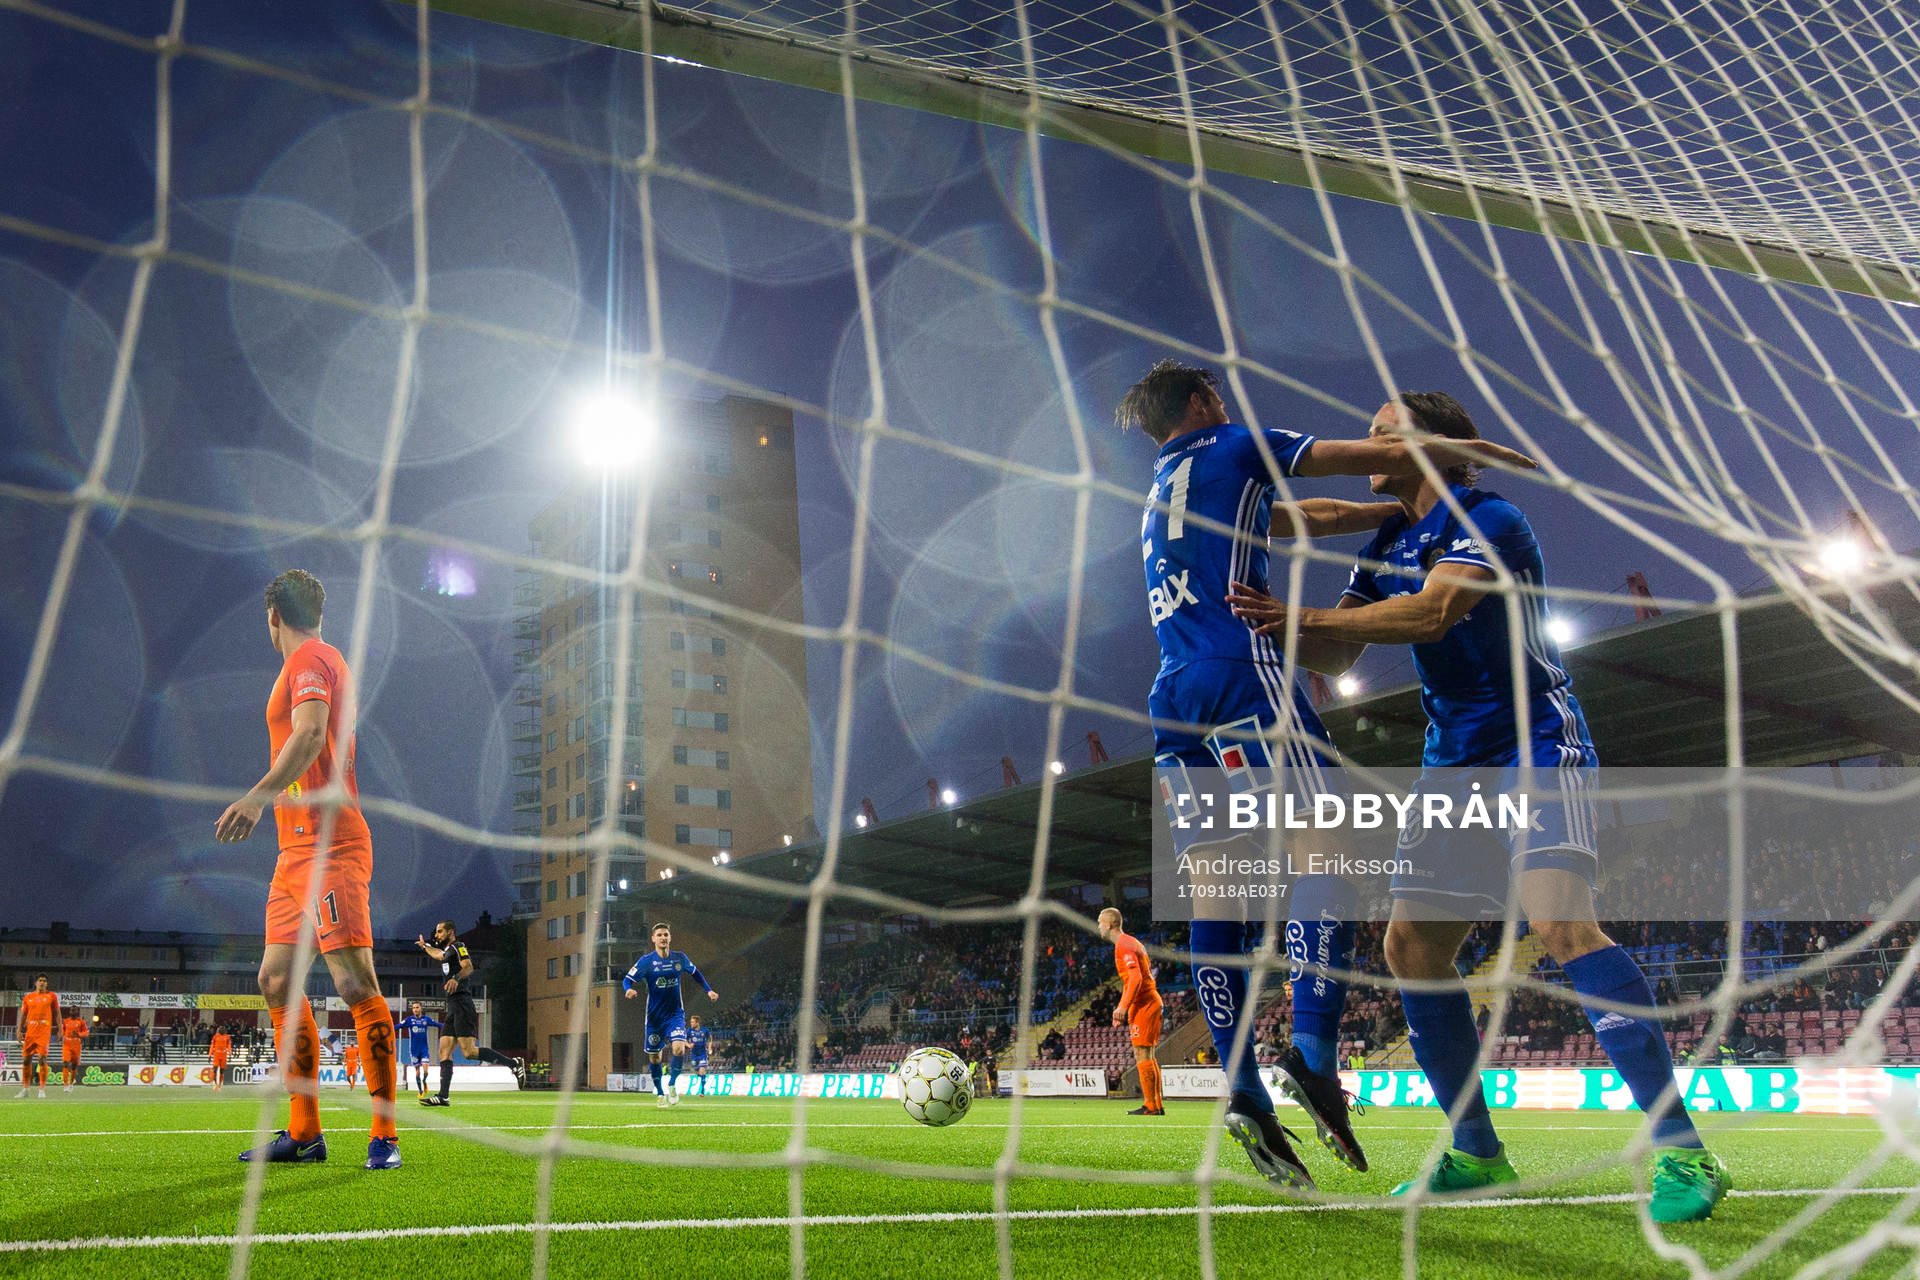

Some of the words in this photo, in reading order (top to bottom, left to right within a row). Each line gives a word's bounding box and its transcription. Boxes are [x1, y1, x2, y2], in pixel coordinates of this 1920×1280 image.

[1149, 569, 1200, 628] BAX
[820, 1074, 885, 1098] PEAB
[1074, 1074, 1097, 1088] Fiks
[1164, 1075, 1175, 1087] La
[1359, 1071, 1519, 1108] PEB
[1579, 1069, 1800, 1113] PAB
